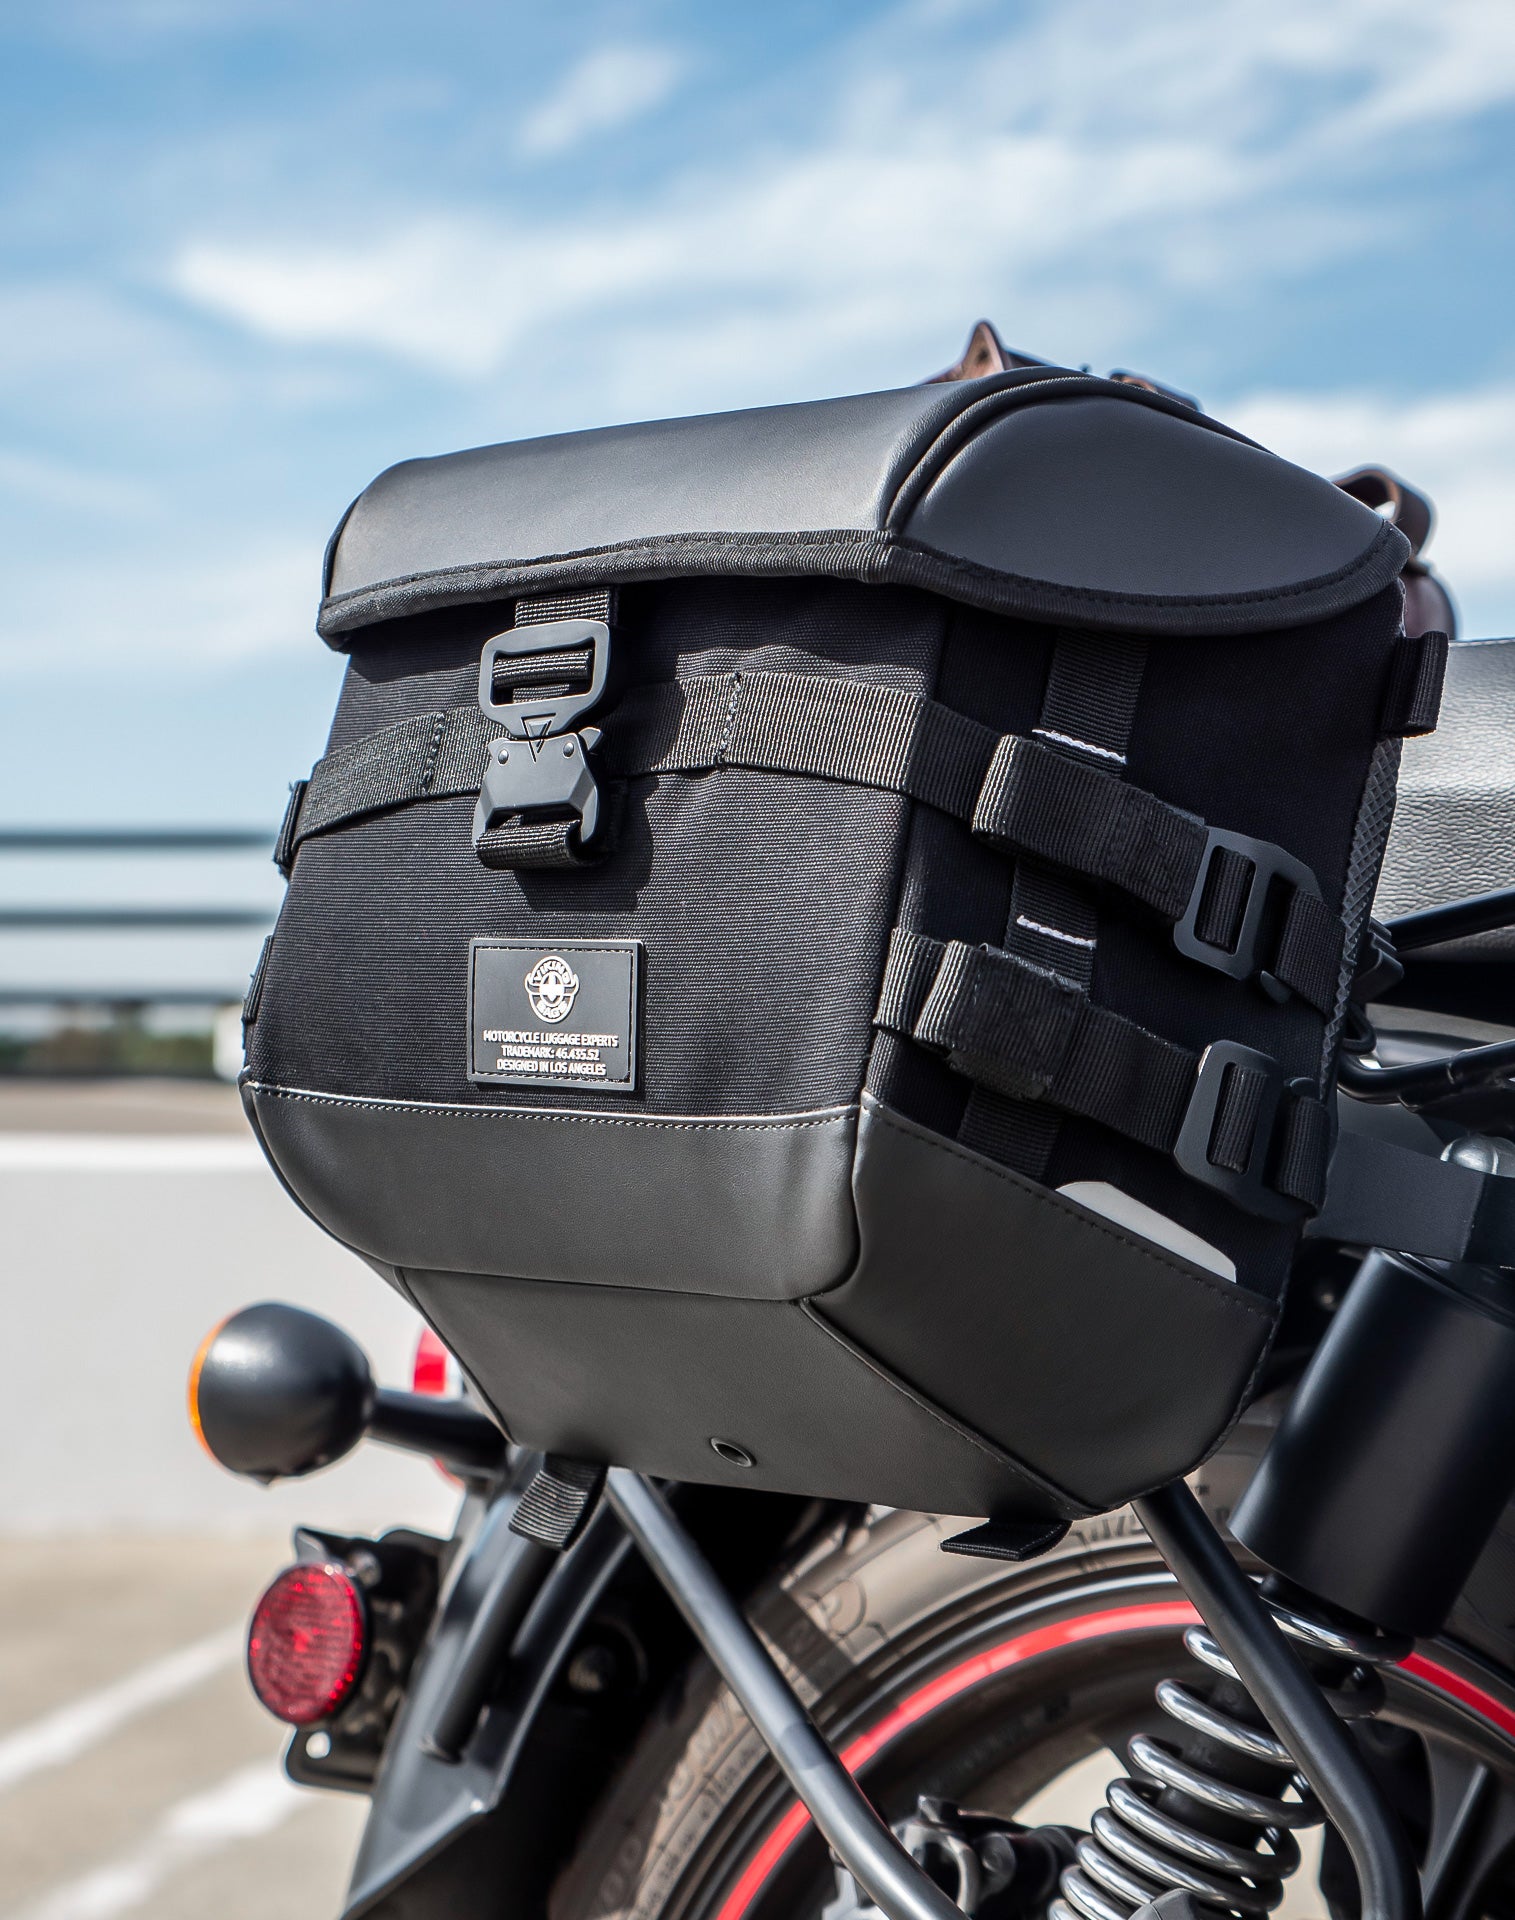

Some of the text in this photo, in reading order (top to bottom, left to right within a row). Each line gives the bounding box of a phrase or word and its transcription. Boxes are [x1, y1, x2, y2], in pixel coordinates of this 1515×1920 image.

[533, 961, 571, 984] VIKING
[536, 1000, 568, 1018] BAGS
[483, 1029, 619, 1048] MOTORCYCLE LUGGAGE EXPERTS
[501, 1045, 555, 1059] TRADEMARK:
[497, 1059, 607, 1076] DESIGNED IN LOS ANGELES
